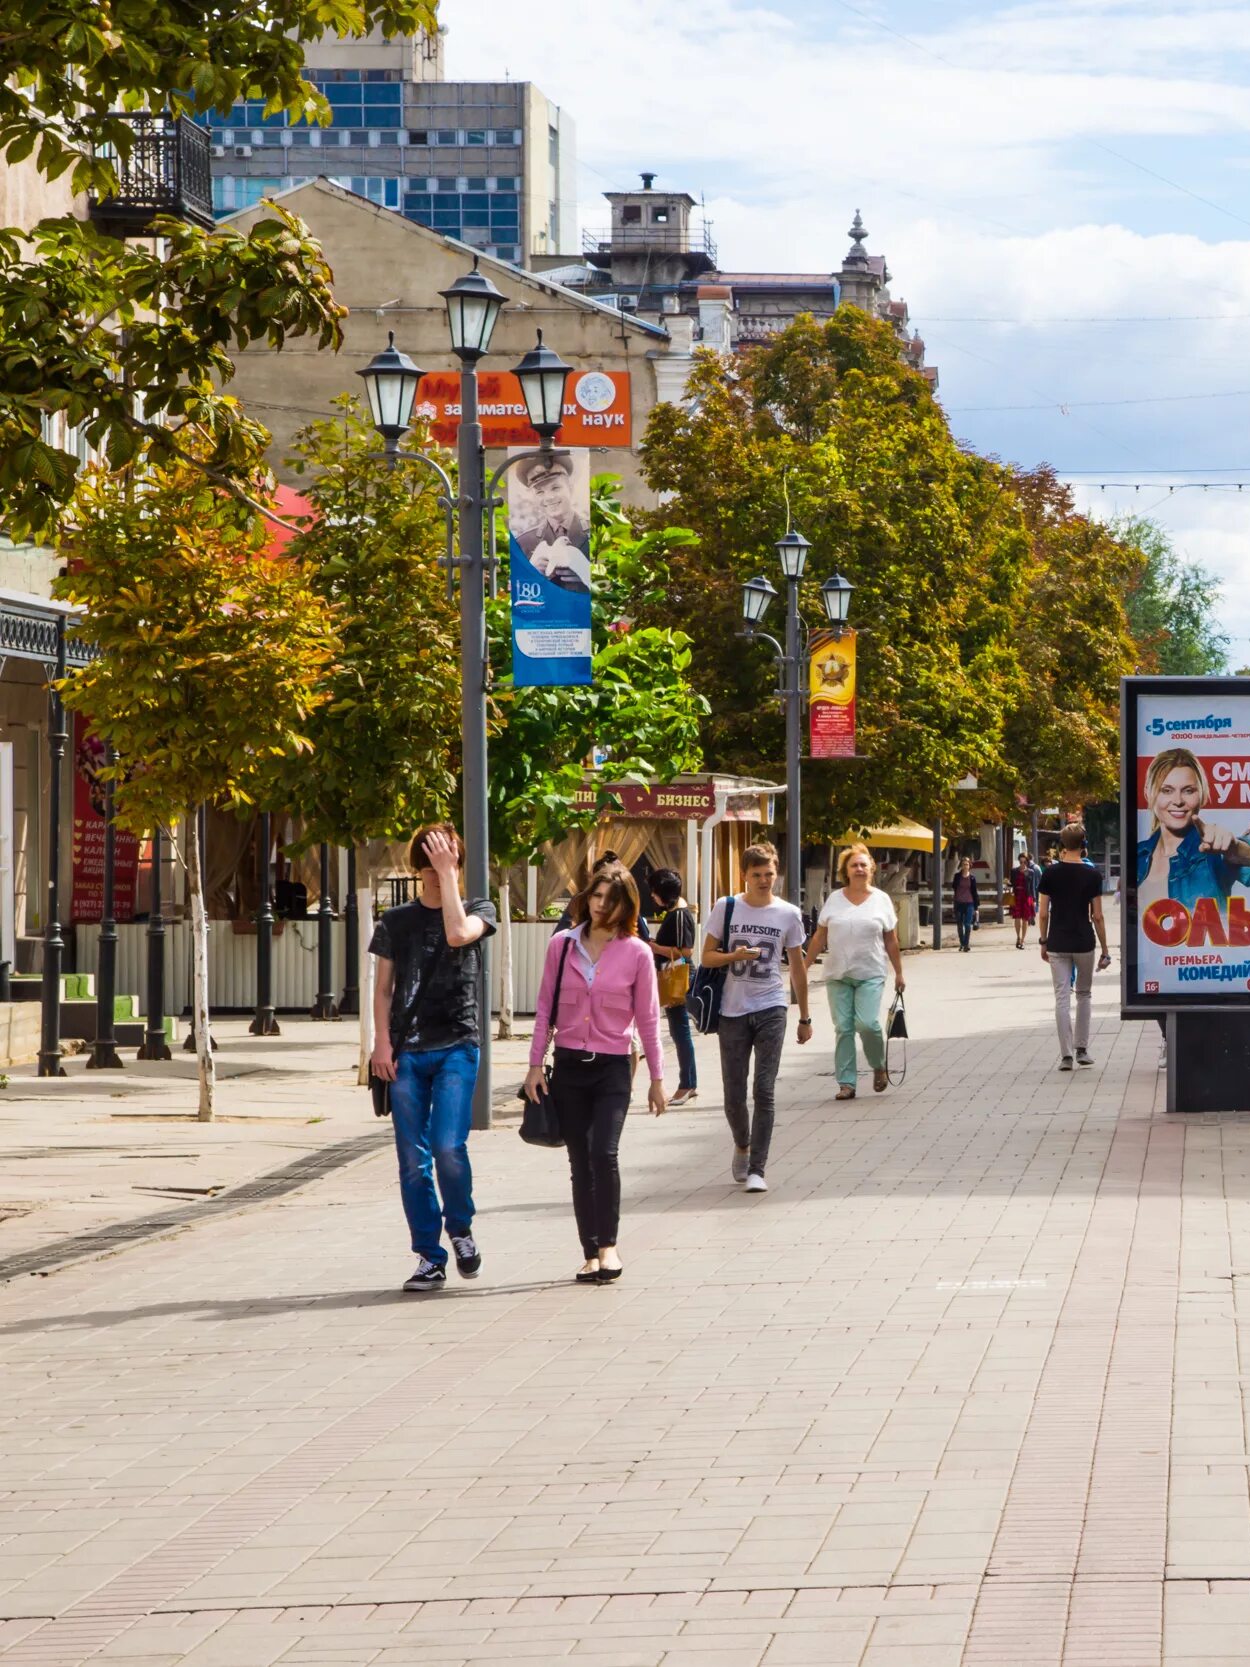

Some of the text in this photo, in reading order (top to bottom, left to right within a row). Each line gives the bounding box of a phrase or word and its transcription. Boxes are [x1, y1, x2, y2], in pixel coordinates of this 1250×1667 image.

[422, 376, 500, 400] Муей
[582, 413, 625, 429] наук
[521, 583, 541, 598] 80
[1152, 718, 1165, 736] 5
[1165, 714, 1232, 732] сентября
[656, 793, 710, 807] БИЗНЕС
[1213, 783, 1234, 804] У
[729, 924, 781, 938] BE AWESOME
[1164, 954, 1223, 966] ПРЕМЬЕРА
